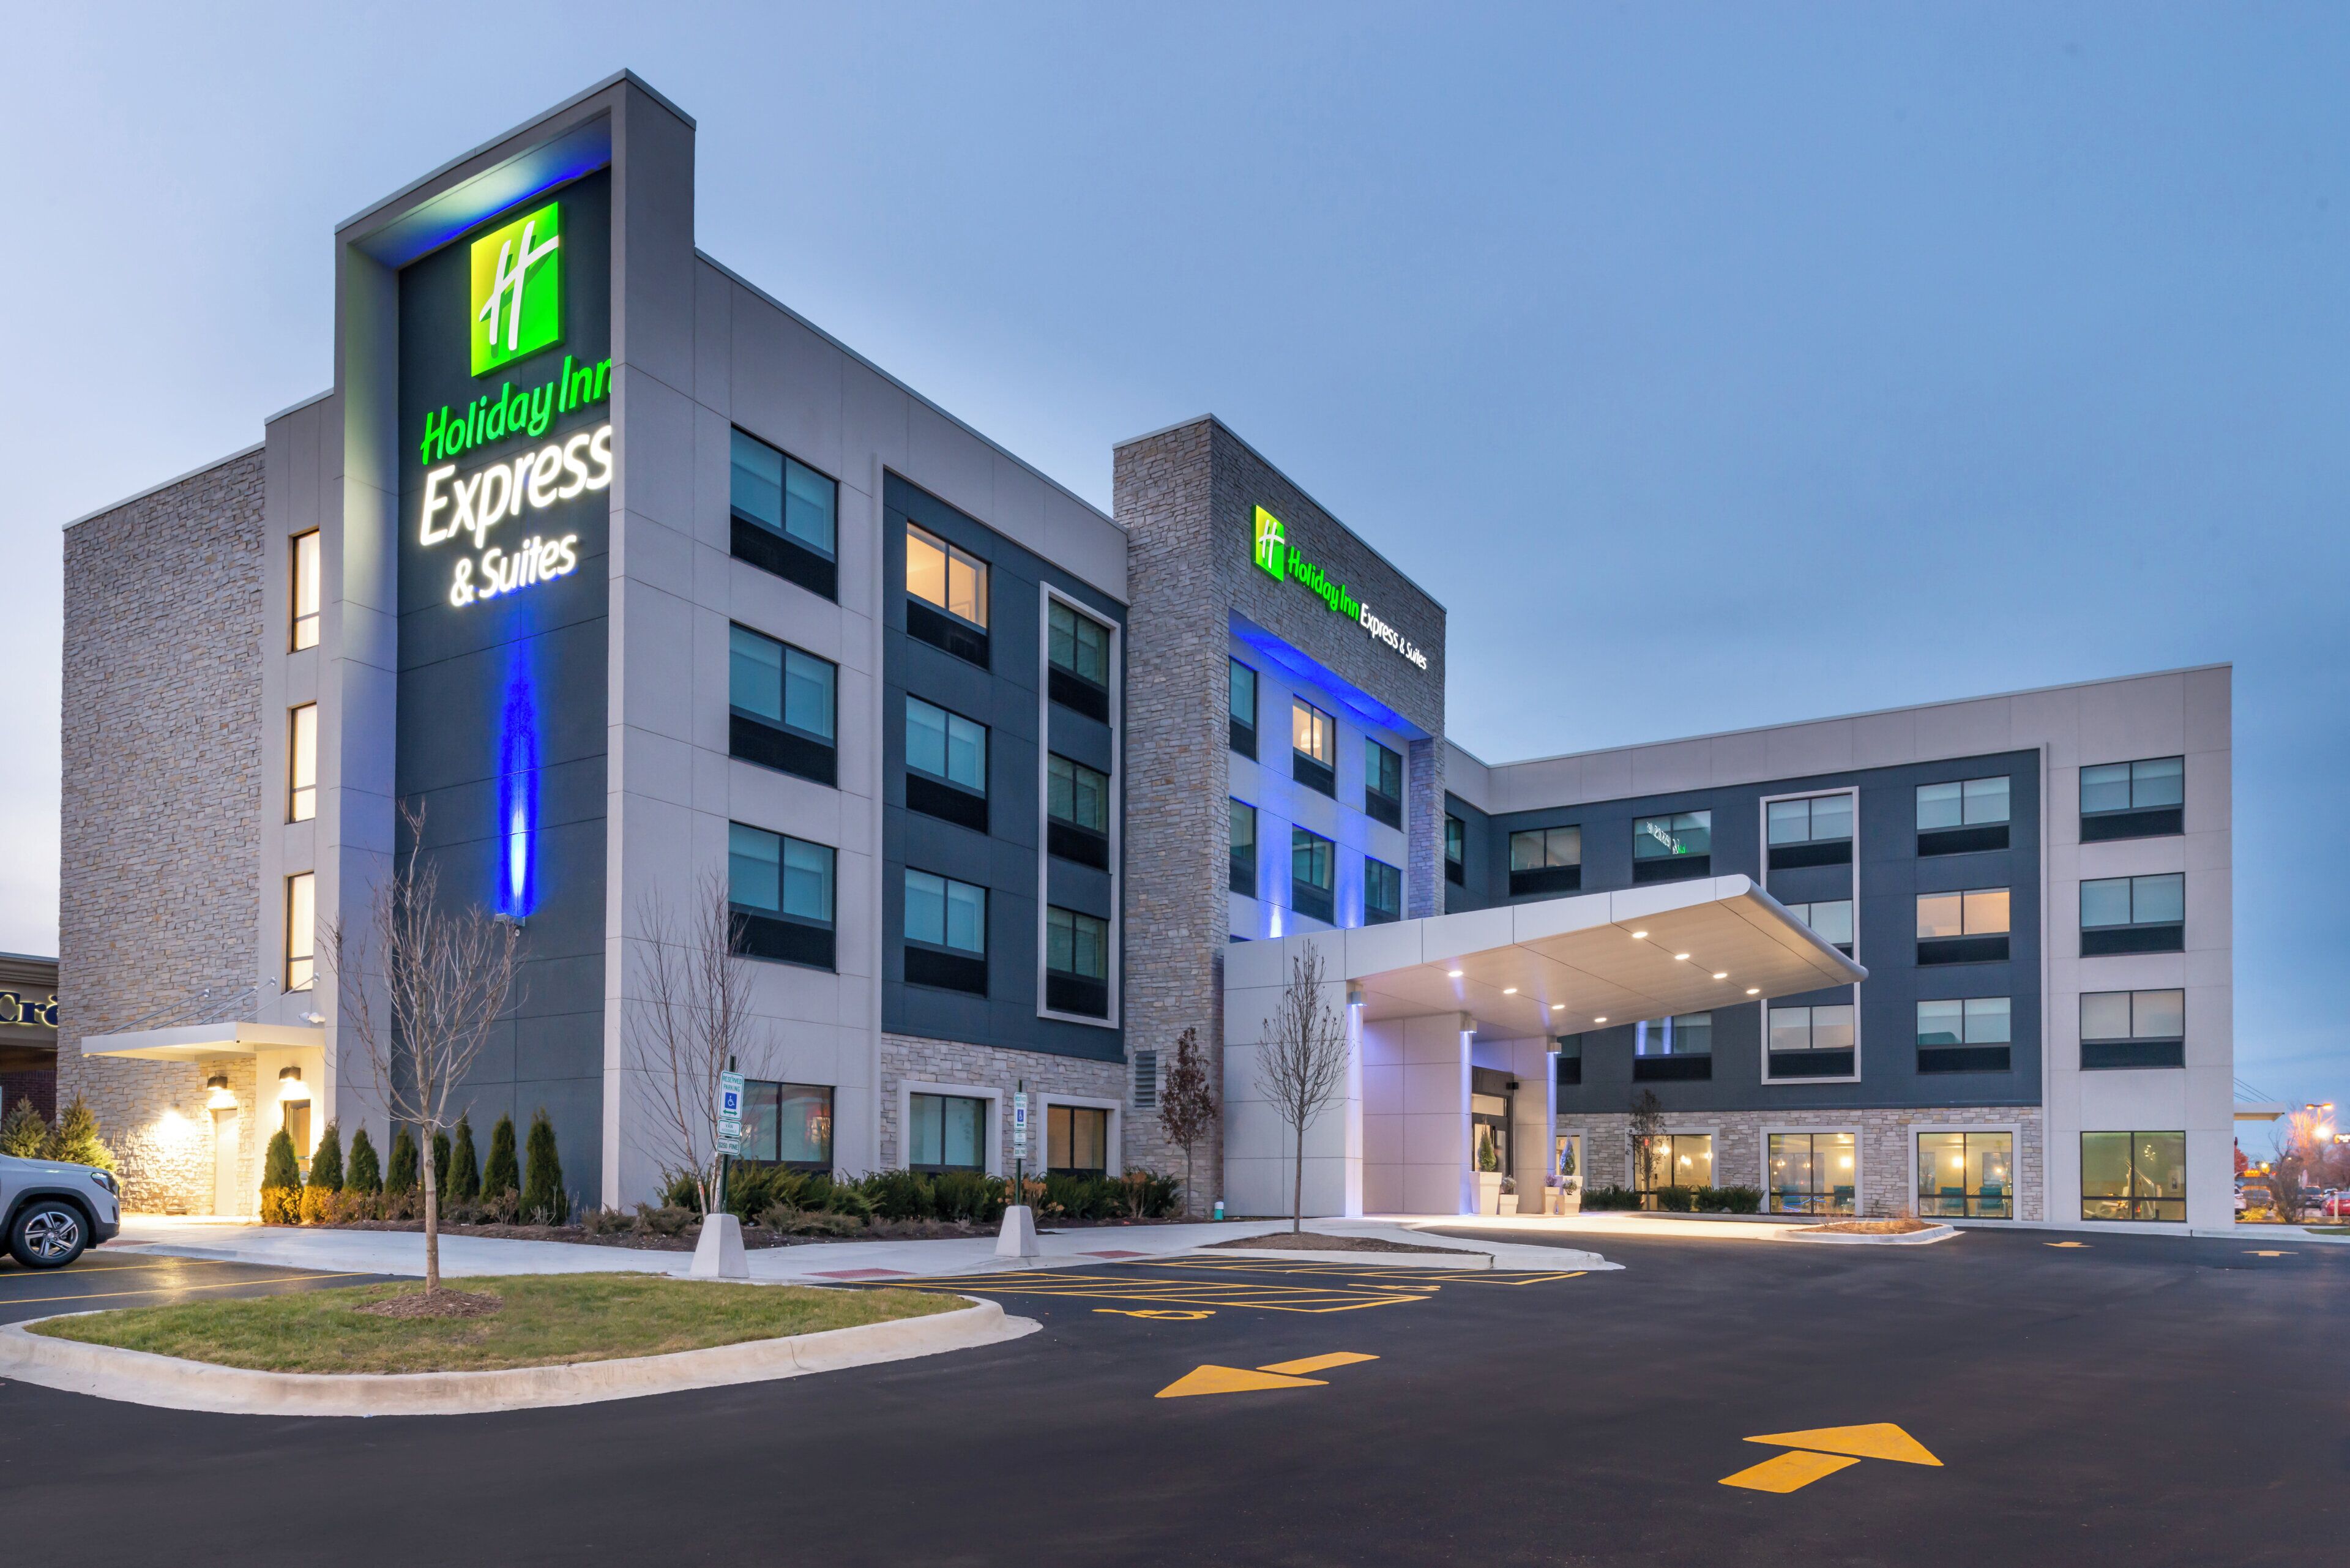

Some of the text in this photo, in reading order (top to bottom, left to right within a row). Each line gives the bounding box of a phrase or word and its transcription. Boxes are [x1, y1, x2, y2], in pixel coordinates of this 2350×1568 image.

[420, 354, 611, 465] Holiday Inn
[420, 425, 612, 548] Express
[450, 534, 578, 607] & Suites
[1288, 546, 1427, 670] Holiday Inn Express & Suites
[722, 1075, 742, 1085] RESERVED
[723, 1083, 740, 1092] PARKING
